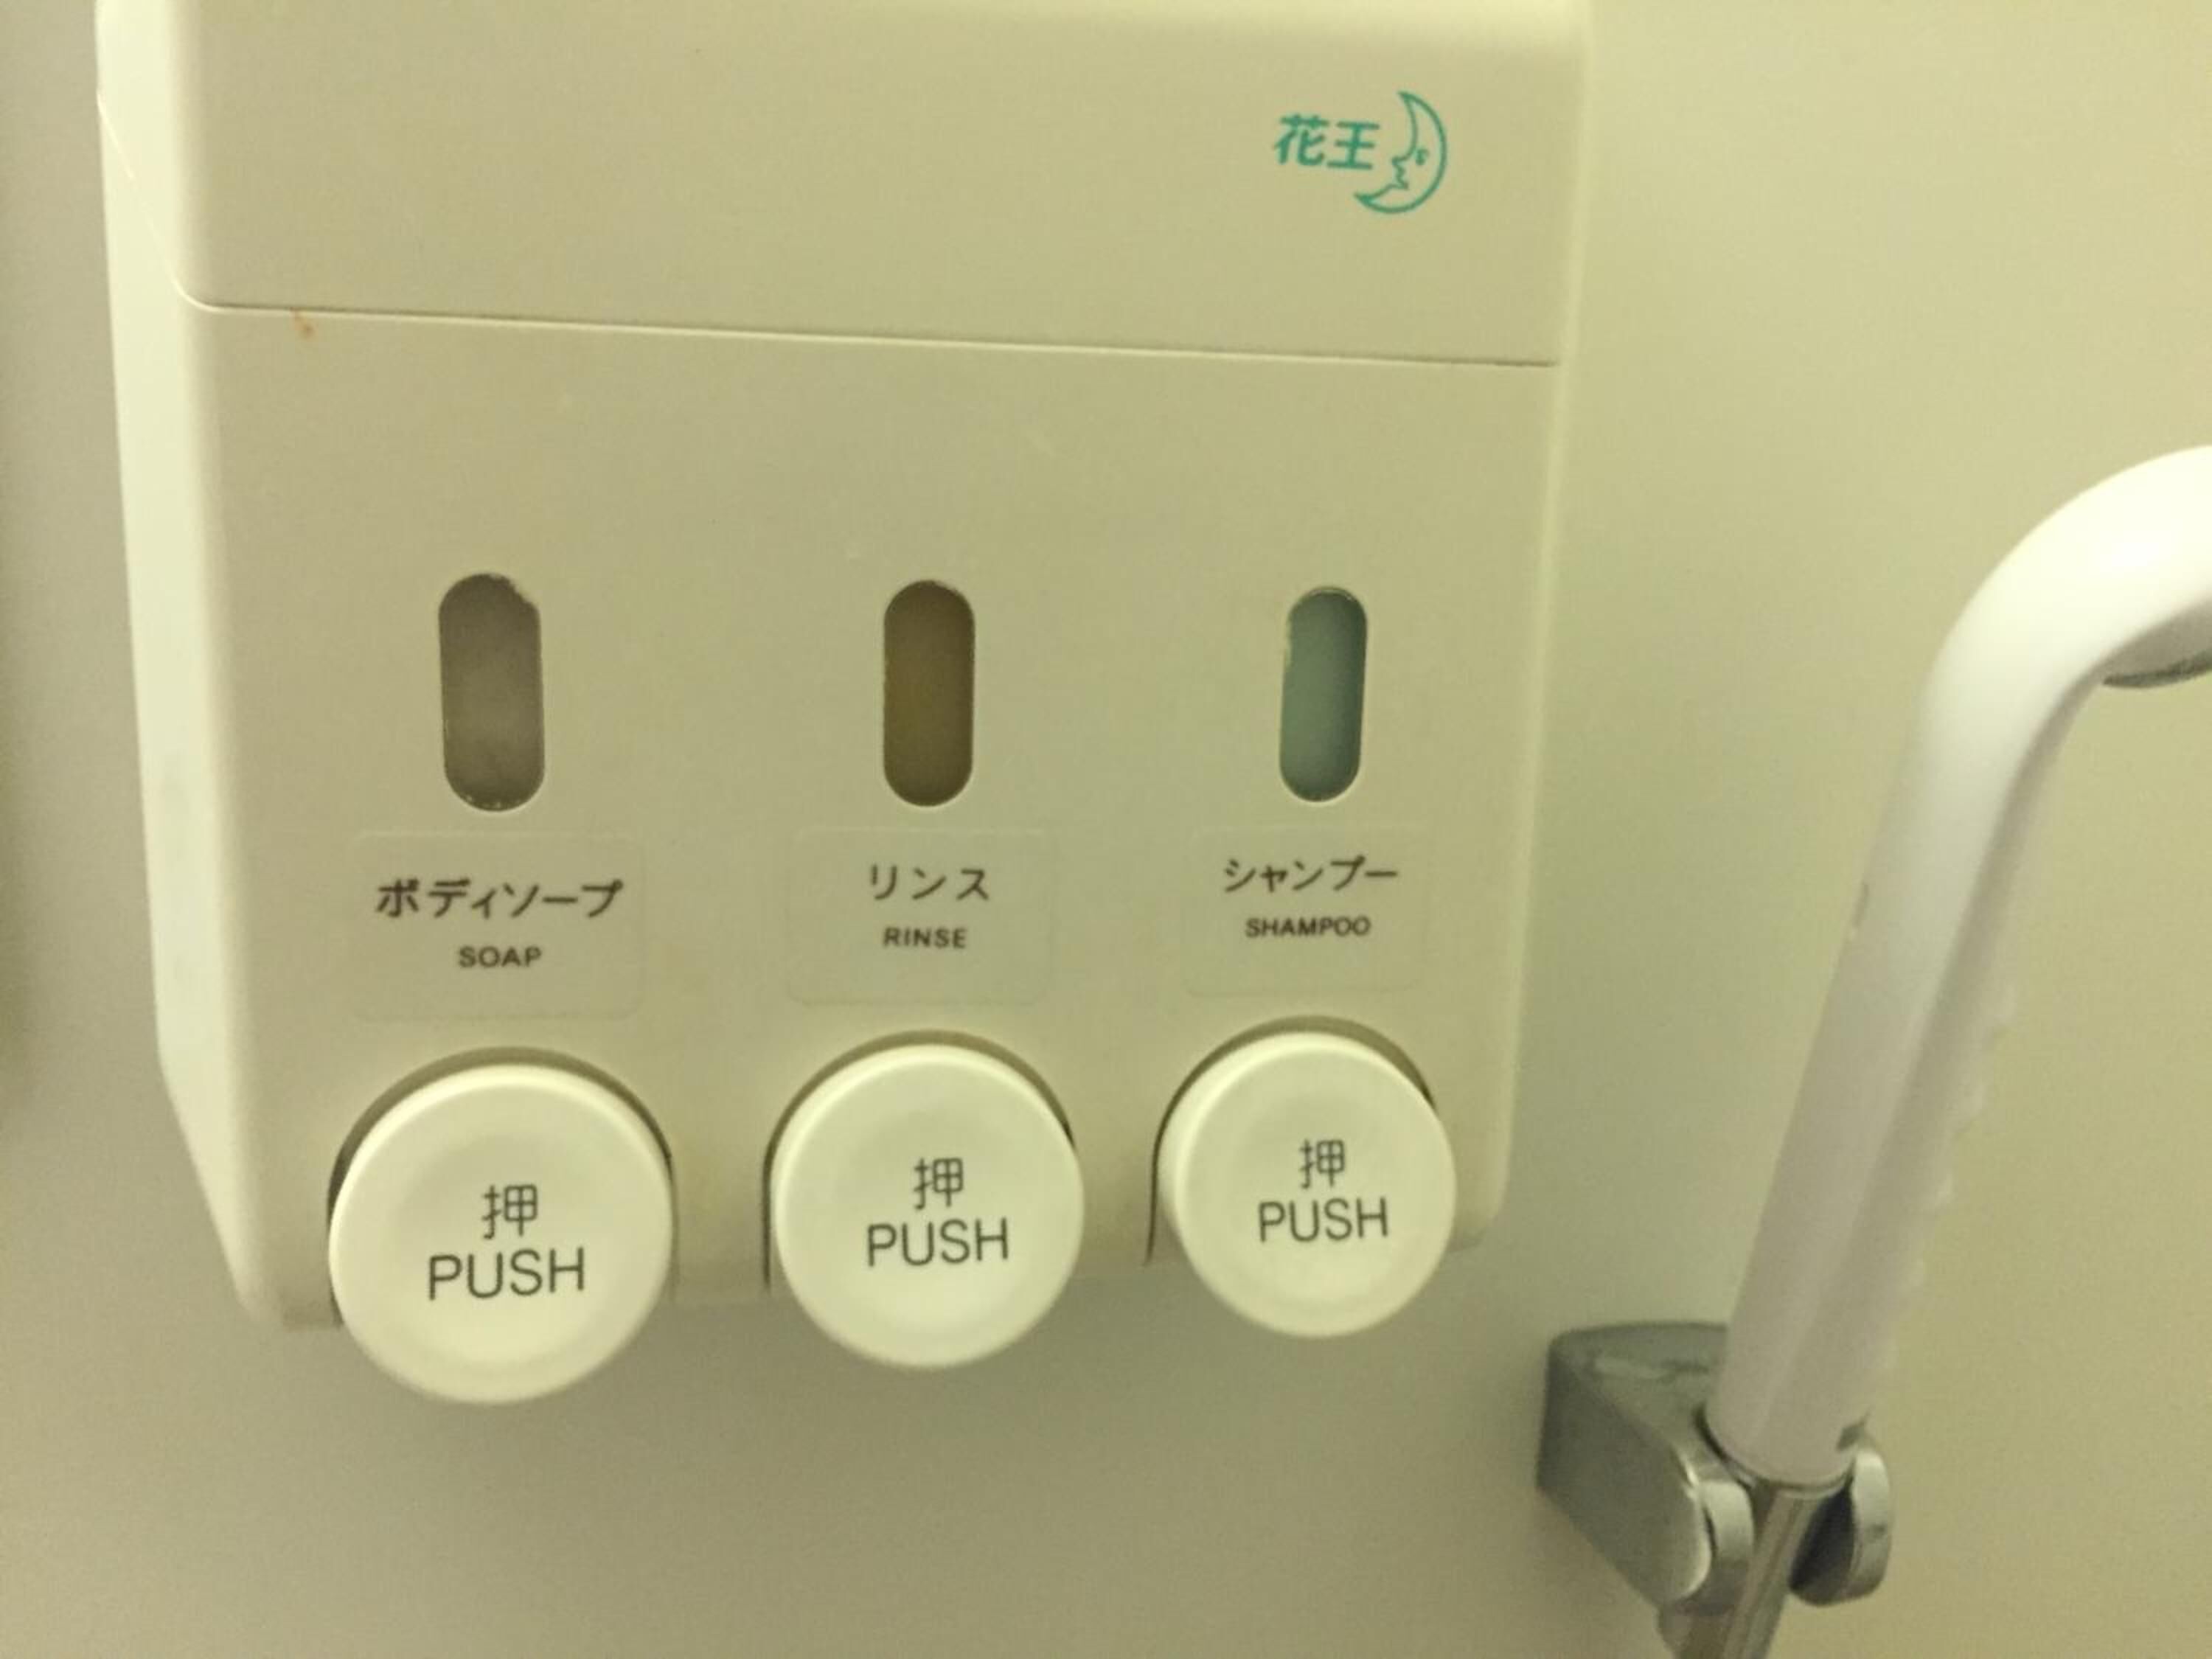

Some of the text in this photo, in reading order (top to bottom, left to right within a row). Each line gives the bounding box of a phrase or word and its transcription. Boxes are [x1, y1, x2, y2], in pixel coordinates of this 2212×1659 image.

[1273, 112, 1381, 171] 花王
[870, 864, 990, 900] リンス
[1223, 855, 1399, 893] シャンプー
[376, 877, 625, 919] ボディソープ
[883, 927, 967, 949] RINSE
[1245, 916, 1372, 938] SHAMPOO
[459, 945, 543, 968] SOAP
[913, 1157, 964, 1211] 押
[1298, 1139, 1346, 1191] 押
[481, 1183, 539, 1241] 押
[1258, 1197, 1390, 1243] PUSH
[866, 1217, 1010, 1267] PUSH
[428, 1246, 586, 1301] PUSH
